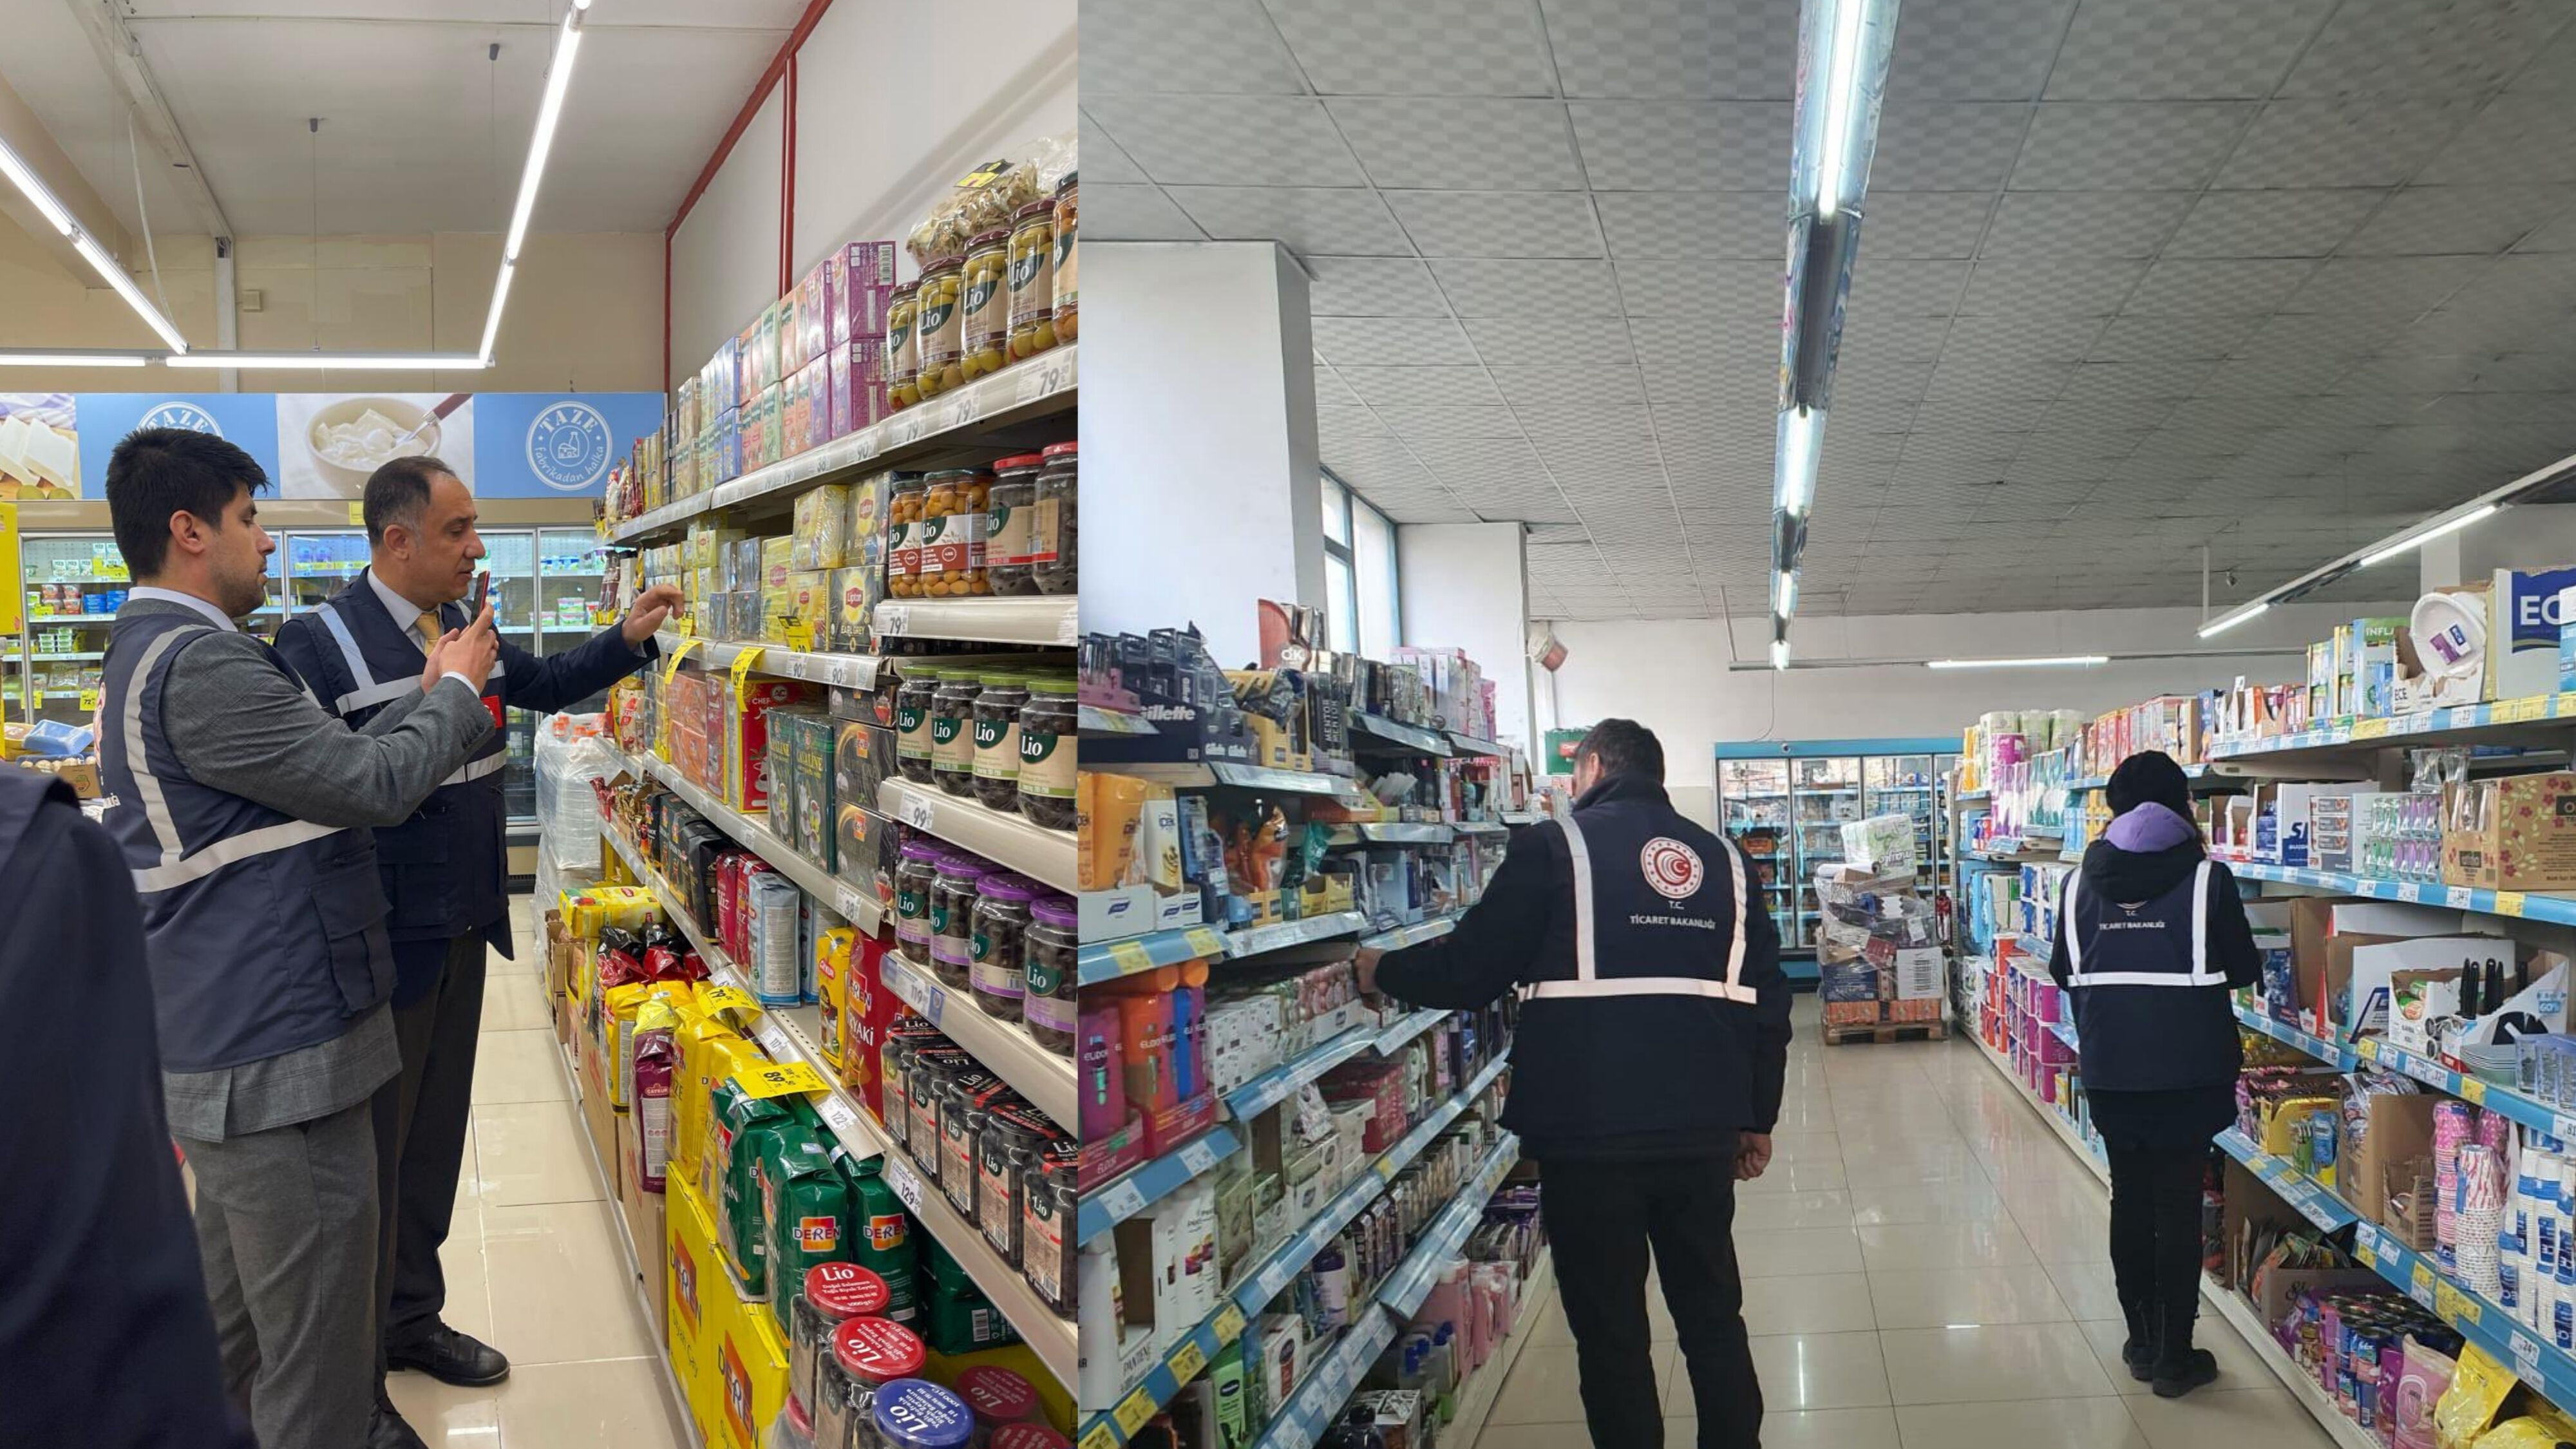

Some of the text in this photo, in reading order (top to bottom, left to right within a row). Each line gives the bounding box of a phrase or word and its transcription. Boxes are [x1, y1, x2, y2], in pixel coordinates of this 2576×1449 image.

[1009, 261, 1029, 286] Lio
[920, 312, 940, 328] Lio
[1039, 368, 1059, 396] 79
[956, 399, 972, 424] 79
[540, 410, 598, 433] TAZE
[906, 420, 919, 442] 79
[535, 446, 604, 482] fabrikadan halka
[922, 522, 936, 538] Lio
[987, 517, 999, 531] Lio
[889, 529, 900, 544] Lio
[847, 592, 862, 603] Lipton
[841, 625, 865, 635] EARL GREY
[890, 616, 902, 634] 79
[793, 663, 802, 677] 90
[832, 667, 842, 684] 90
[899, 712, 914, 728] Lio
[1323, 699, 1332, 741] MENTOR
[934, 721, 951, 738] Lio
[975, 723, 995, 742] Lio
[1021, 735, 1043, 756] Lio
[913, 806, 927, 828] 99
[844, 900, 855, 919] 38
[898, 896, 914, 912] Lio
[1668, 900, 1684, 910] T.C.
[1630, 914, 1716, 929] TİCARET BAKANLIĞI
[2126, 920, 2166, 929] BAKANLIĞI
[1027, 965, 1047, 988] Lio
[710, 989, 726, 998] 79
[911, 984, 923, 1003] 119
[905, 1020, 929, 1028] Lio
[943, 1057, 969, 1066] Lio
[763, 1072, 785, 1083] 89
[960, 1074, 982, 1086] Lio
[916, 1092, 925, 1106] Lio
[831, 1111, 848, 1125] 122
[948, 1122, 959, 1137] Lio
[986, 1157, 998, 1173] Lio
[901, 1182, 914, 1204] 129
[1032, 1197, 1047, 1217] Lio
[793, 1227, 841, 1240] DEREN
[864, 1224, 909, 1240] DEREN
[820, 1267, 855, 1282] Lio
[670, 1244, 702, 1332] DEREN
[848, 1339, 882, 1363] Lio
[718, 1343, 759, 1448] DEREN
[943, 1394, 959, 1407] 1000
[971, 1387, 1002, 1408] Lio
[905, 1394, 944, 1425] Siyah Zeytin
[906, 1388, 954, 1424] Doğal Salamura
[890, 1405, 929, 1433] Lio
[922, 1414, 940, 1428] Yağlı
